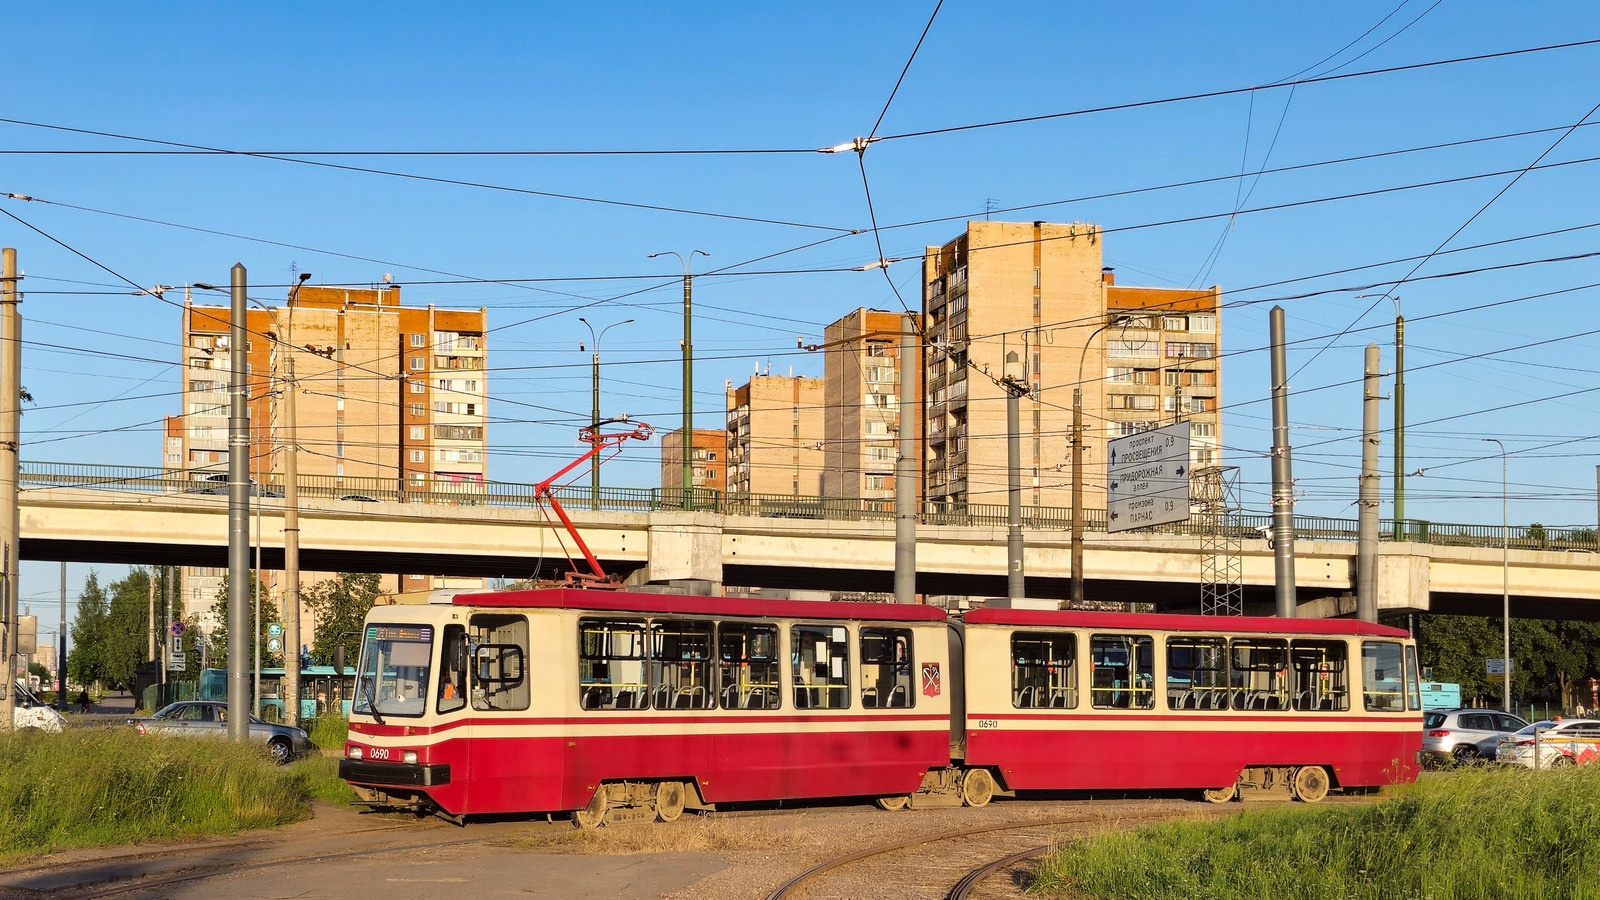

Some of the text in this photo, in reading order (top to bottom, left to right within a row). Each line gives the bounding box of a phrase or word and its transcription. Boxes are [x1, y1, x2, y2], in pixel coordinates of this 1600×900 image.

[1129, 435, 1154, 450] проспект
[1121, 445, 1163, 463] ПРОСВЕЩЕНИЯ
[1120, 465, 1163, 483] ПРИДОРОЖНАЯ
[1133, 482, 1149, 492] аллея
[1128, 498, 1154, 512] промзона
[1129, 511, 1153, 524] ПАРНАС
[978, 720, 998, 728] 0690
[370, 748, 389, 760] 0690
